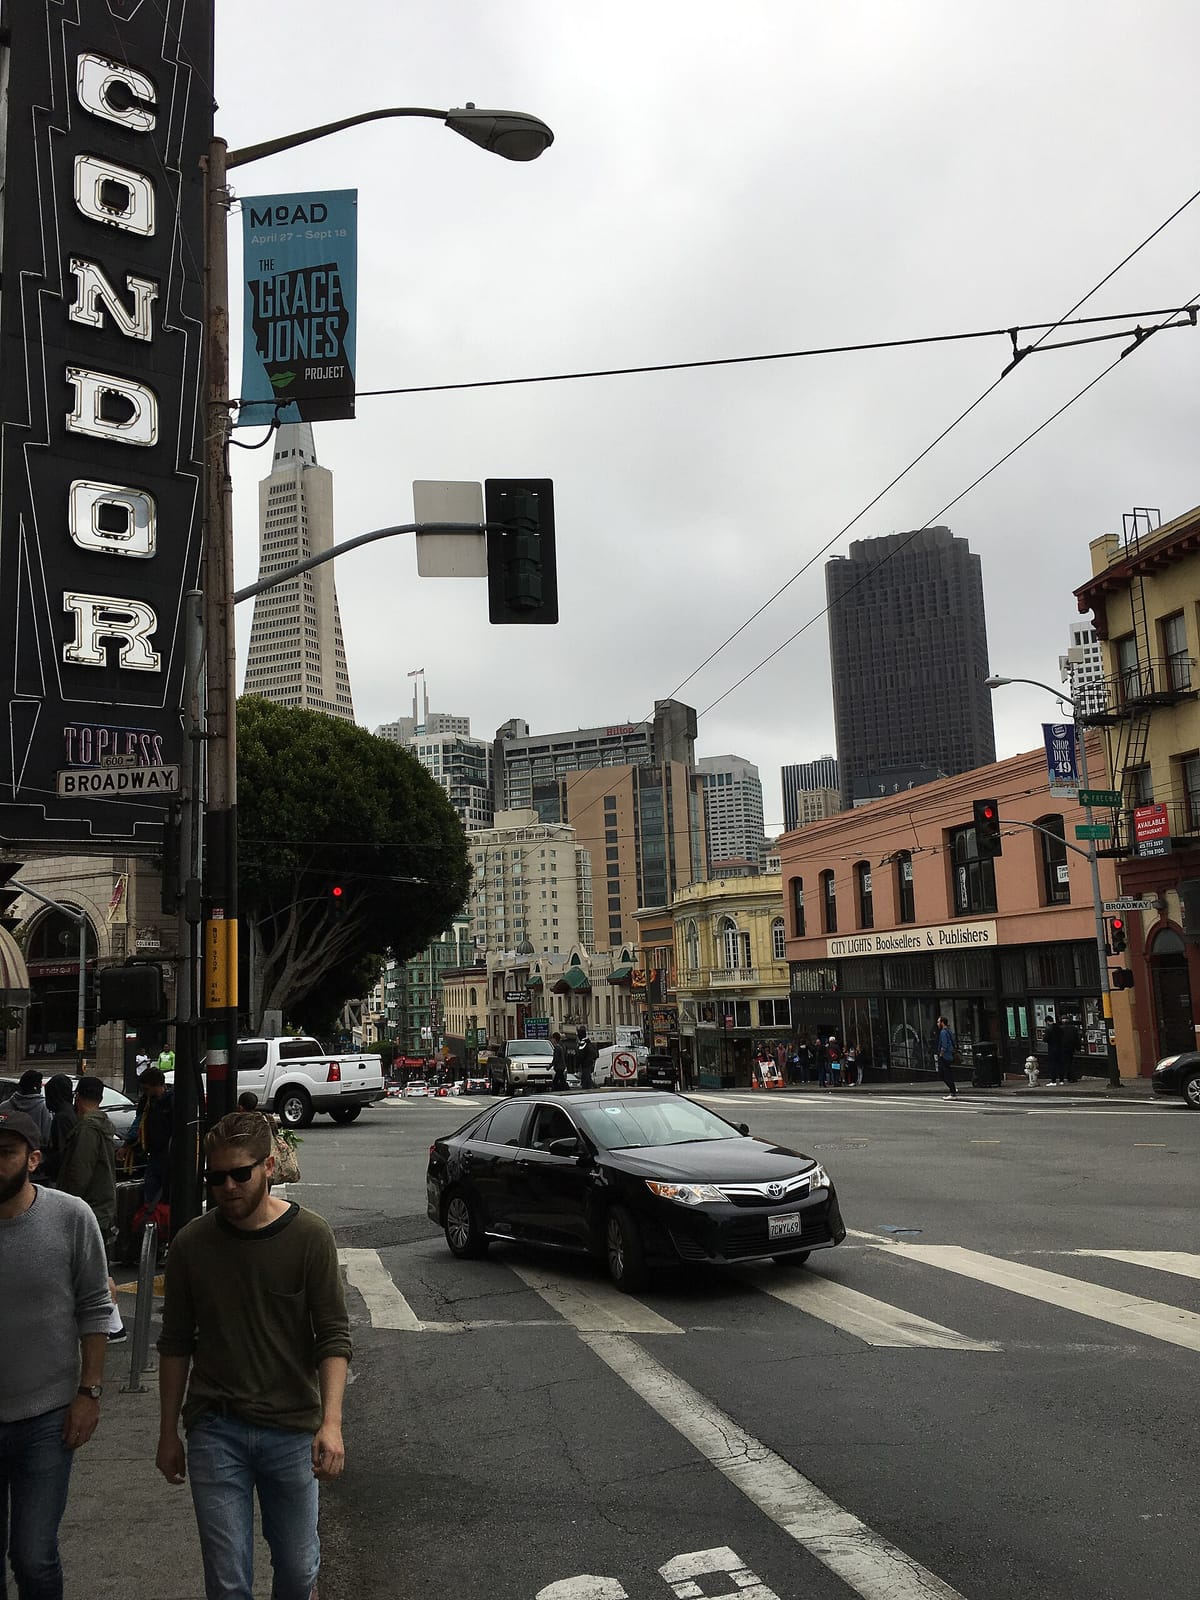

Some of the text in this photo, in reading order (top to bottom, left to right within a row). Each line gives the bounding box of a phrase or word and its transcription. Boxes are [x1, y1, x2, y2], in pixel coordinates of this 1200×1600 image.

[251, 232, 278, 246] April
[280, 232, 294, 242] 27
[305, 230, 332, 241] Sept
[335, 229, 347, 237] 18
[259, 259, 275, 272] THE
[259, 271, 341, 318] GRACE
[258, 316, 340, 364] JONES
[63, 50, 162, 675] CONDOR
[305, 366, 345, 380] PROJECT
[106, 757, 124, 766] 600
[64, 770, 174, 793] BROADWAY
[1137, 817, 1166, 830] AVAILABLE
[1105, 901, 1149, 910] BROADWAY
[831, 928, 989, 954] CITY LIGHTS Booksellers & Publishers
